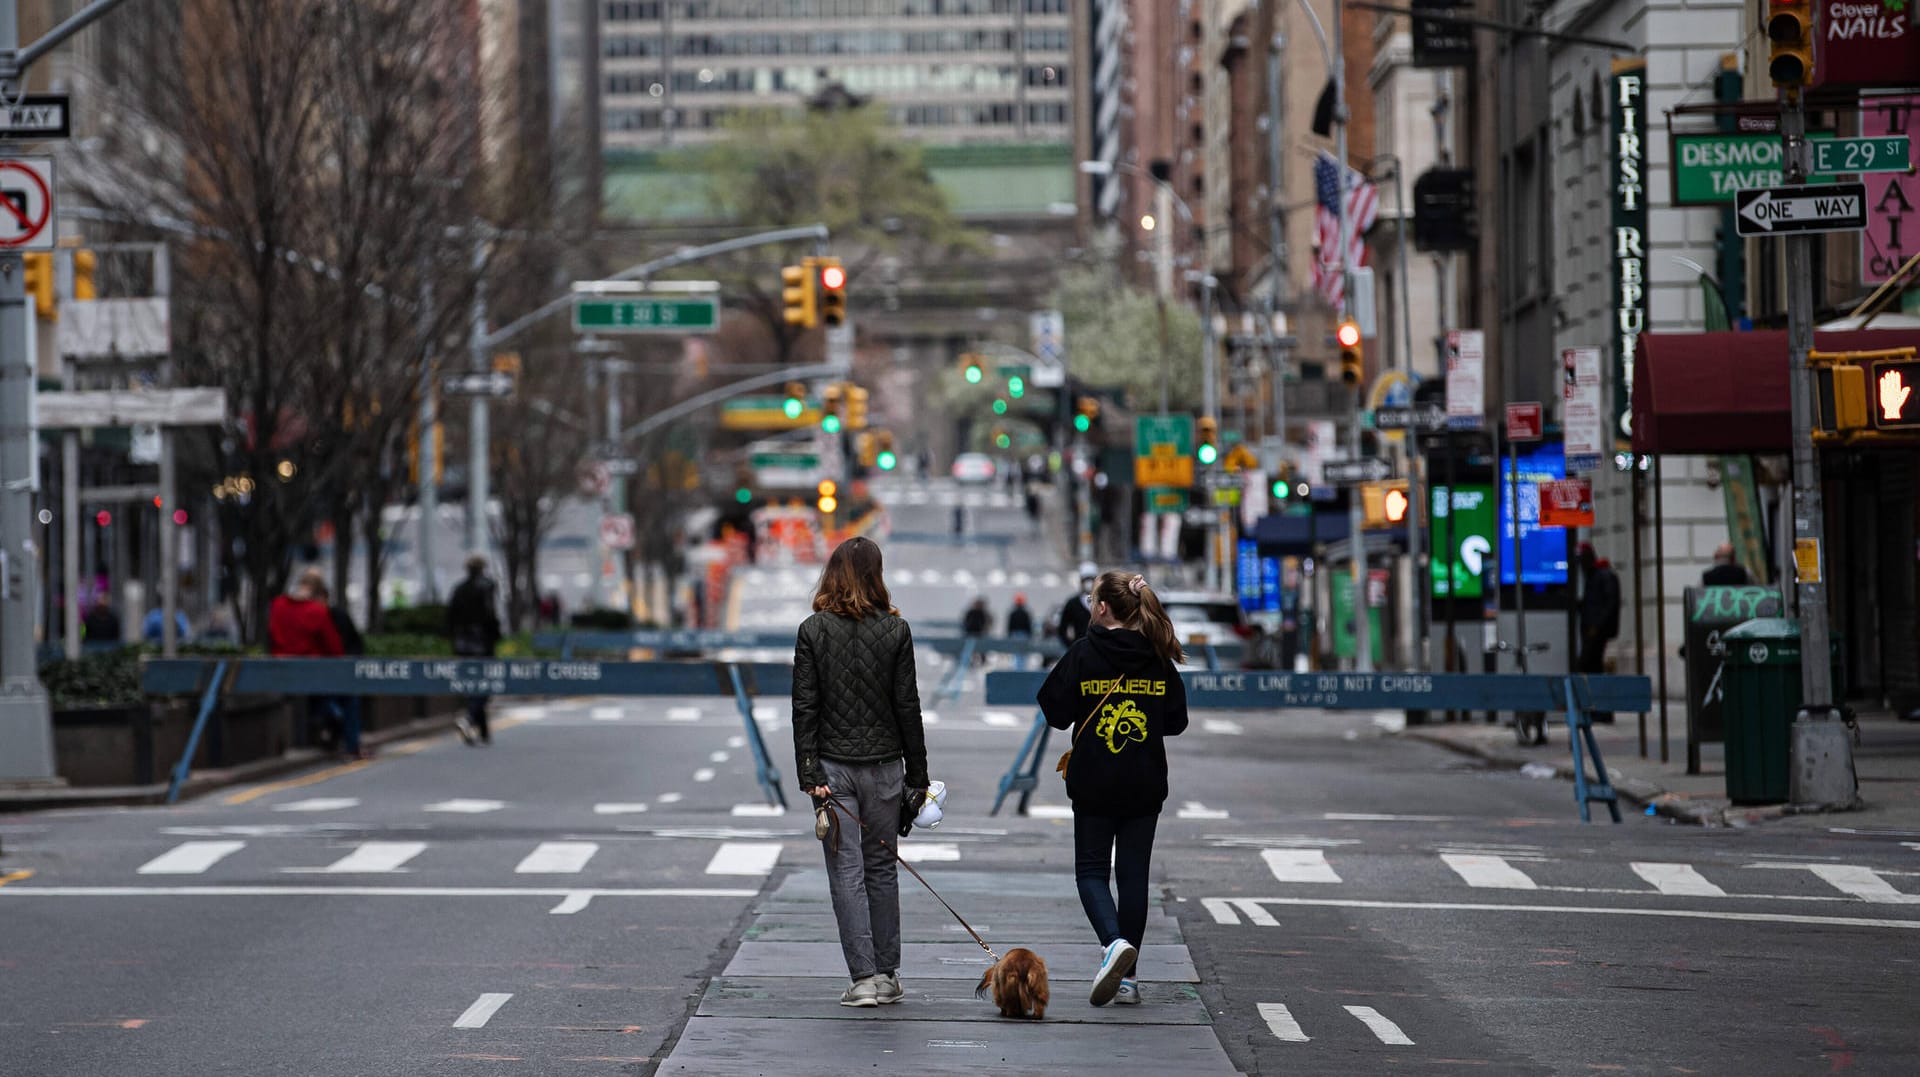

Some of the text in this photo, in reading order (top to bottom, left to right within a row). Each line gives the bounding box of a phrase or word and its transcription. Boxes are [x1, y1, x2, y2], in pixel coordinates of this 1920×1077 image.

[1830, 2, 1879, 18] Clover
[1827, 15, 1906, 41] NAILS
[8, 107, 51, 128] WAY
[1617, 76, 1642, 211] FIRST
[1818, 141, 1901, 169] E 29 ST
[1755, 198, 1855, 220] ONE WAY
[355, 660, 411, 679] POLICE
[422, 660, 458, 680] LINE
[509, 660, 542, 680] NOT
[547, 661, 602, 681] CROSS
[1080, 679, 1167, 697] ROBOJESUS
[1191, 675, 1246, 692] POLICE
[1257, 675, 1294, 692] LINE
[1316, 675, 1339, 692] DO
[1343, 675, 1375, 692] NOT
[1380, 675, 1434, 693] CROSS
[1284, 692, 1338, 706] NYPD
